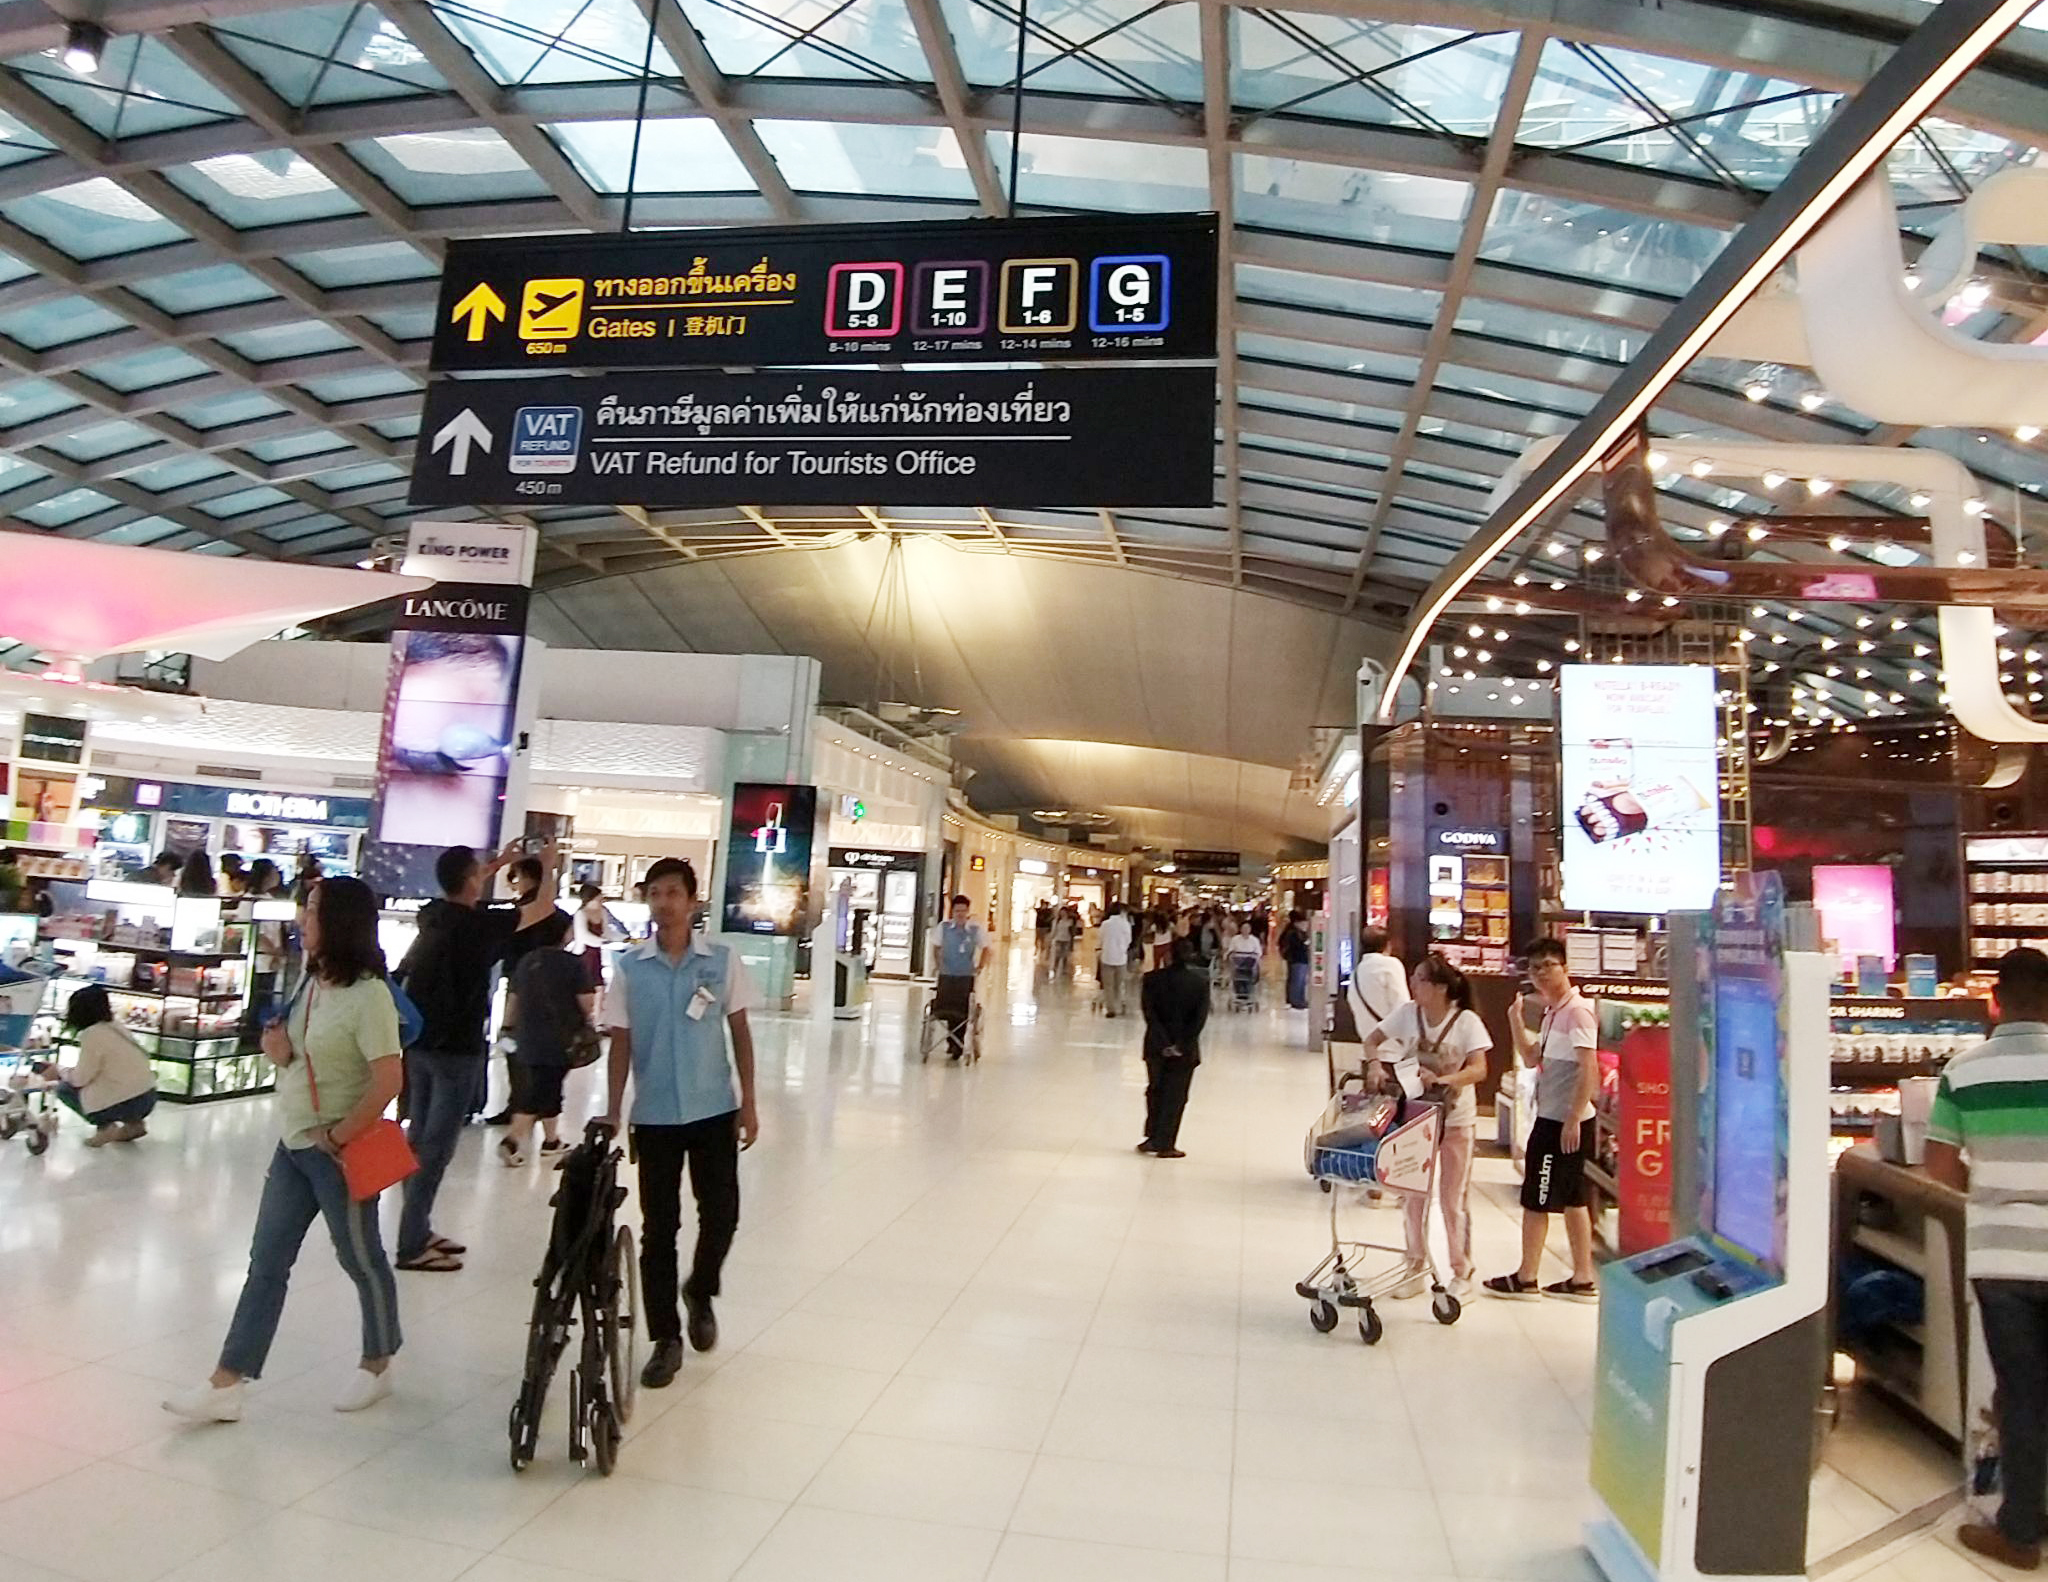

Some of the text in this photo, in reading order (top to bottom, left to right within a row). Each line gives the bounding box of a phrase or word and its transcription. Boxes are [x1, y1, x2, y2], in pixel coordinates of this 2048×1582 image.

[594, 256, 796, 297] ทางออกขึ้นเครื่อง
[848, 272, 886, 311] D
[932, 269, 968, 309] E
[1021, 267, 1056, 307] F
[1108, 264, 1150, 306] G
[848, 314, 879, 327] 5-8
[930, 312, 967, 326] 1-10
[1022, 309, 1052, 324] 1-6
[1115, 307, 1145, 322] 1-5
[588, 316, 657, 338] Gates
[683, 315, 746, 337] 登机门
[526, 342, 553, 354] 650
[860, 340, 891, 351] mins
[951, 339, 983, 350] mins
[1039, 337, 1072, 349] mins
[1132, 335, 1164, 347] mins
[597, 382, 1071, 435] คืนภาษีมูลค่าเพิ่มให้แก่นักท่องเที่ยว
[525, 413, 575, 436] VAT
[520, 440, 572, 451] REFUND
[590, 449, 976, 475] VAT Refund for Tourists Office
[515, 480, 546, 495] 450
[418, 544, 510, 559] KING POWER
[404, 598, 509, 621] LANCÔME
[226, 793, 327, 820] BIOTHERM
[1440, 831, 1497, 845] GODIVA
[1607, 984, 1630, 994] FOR
[1630, 985, 1670, 996] SHARIN
[1828, 1006, 1905, 1018] OR SHARING
[1636, 1082, 1670, 1095] SHO
